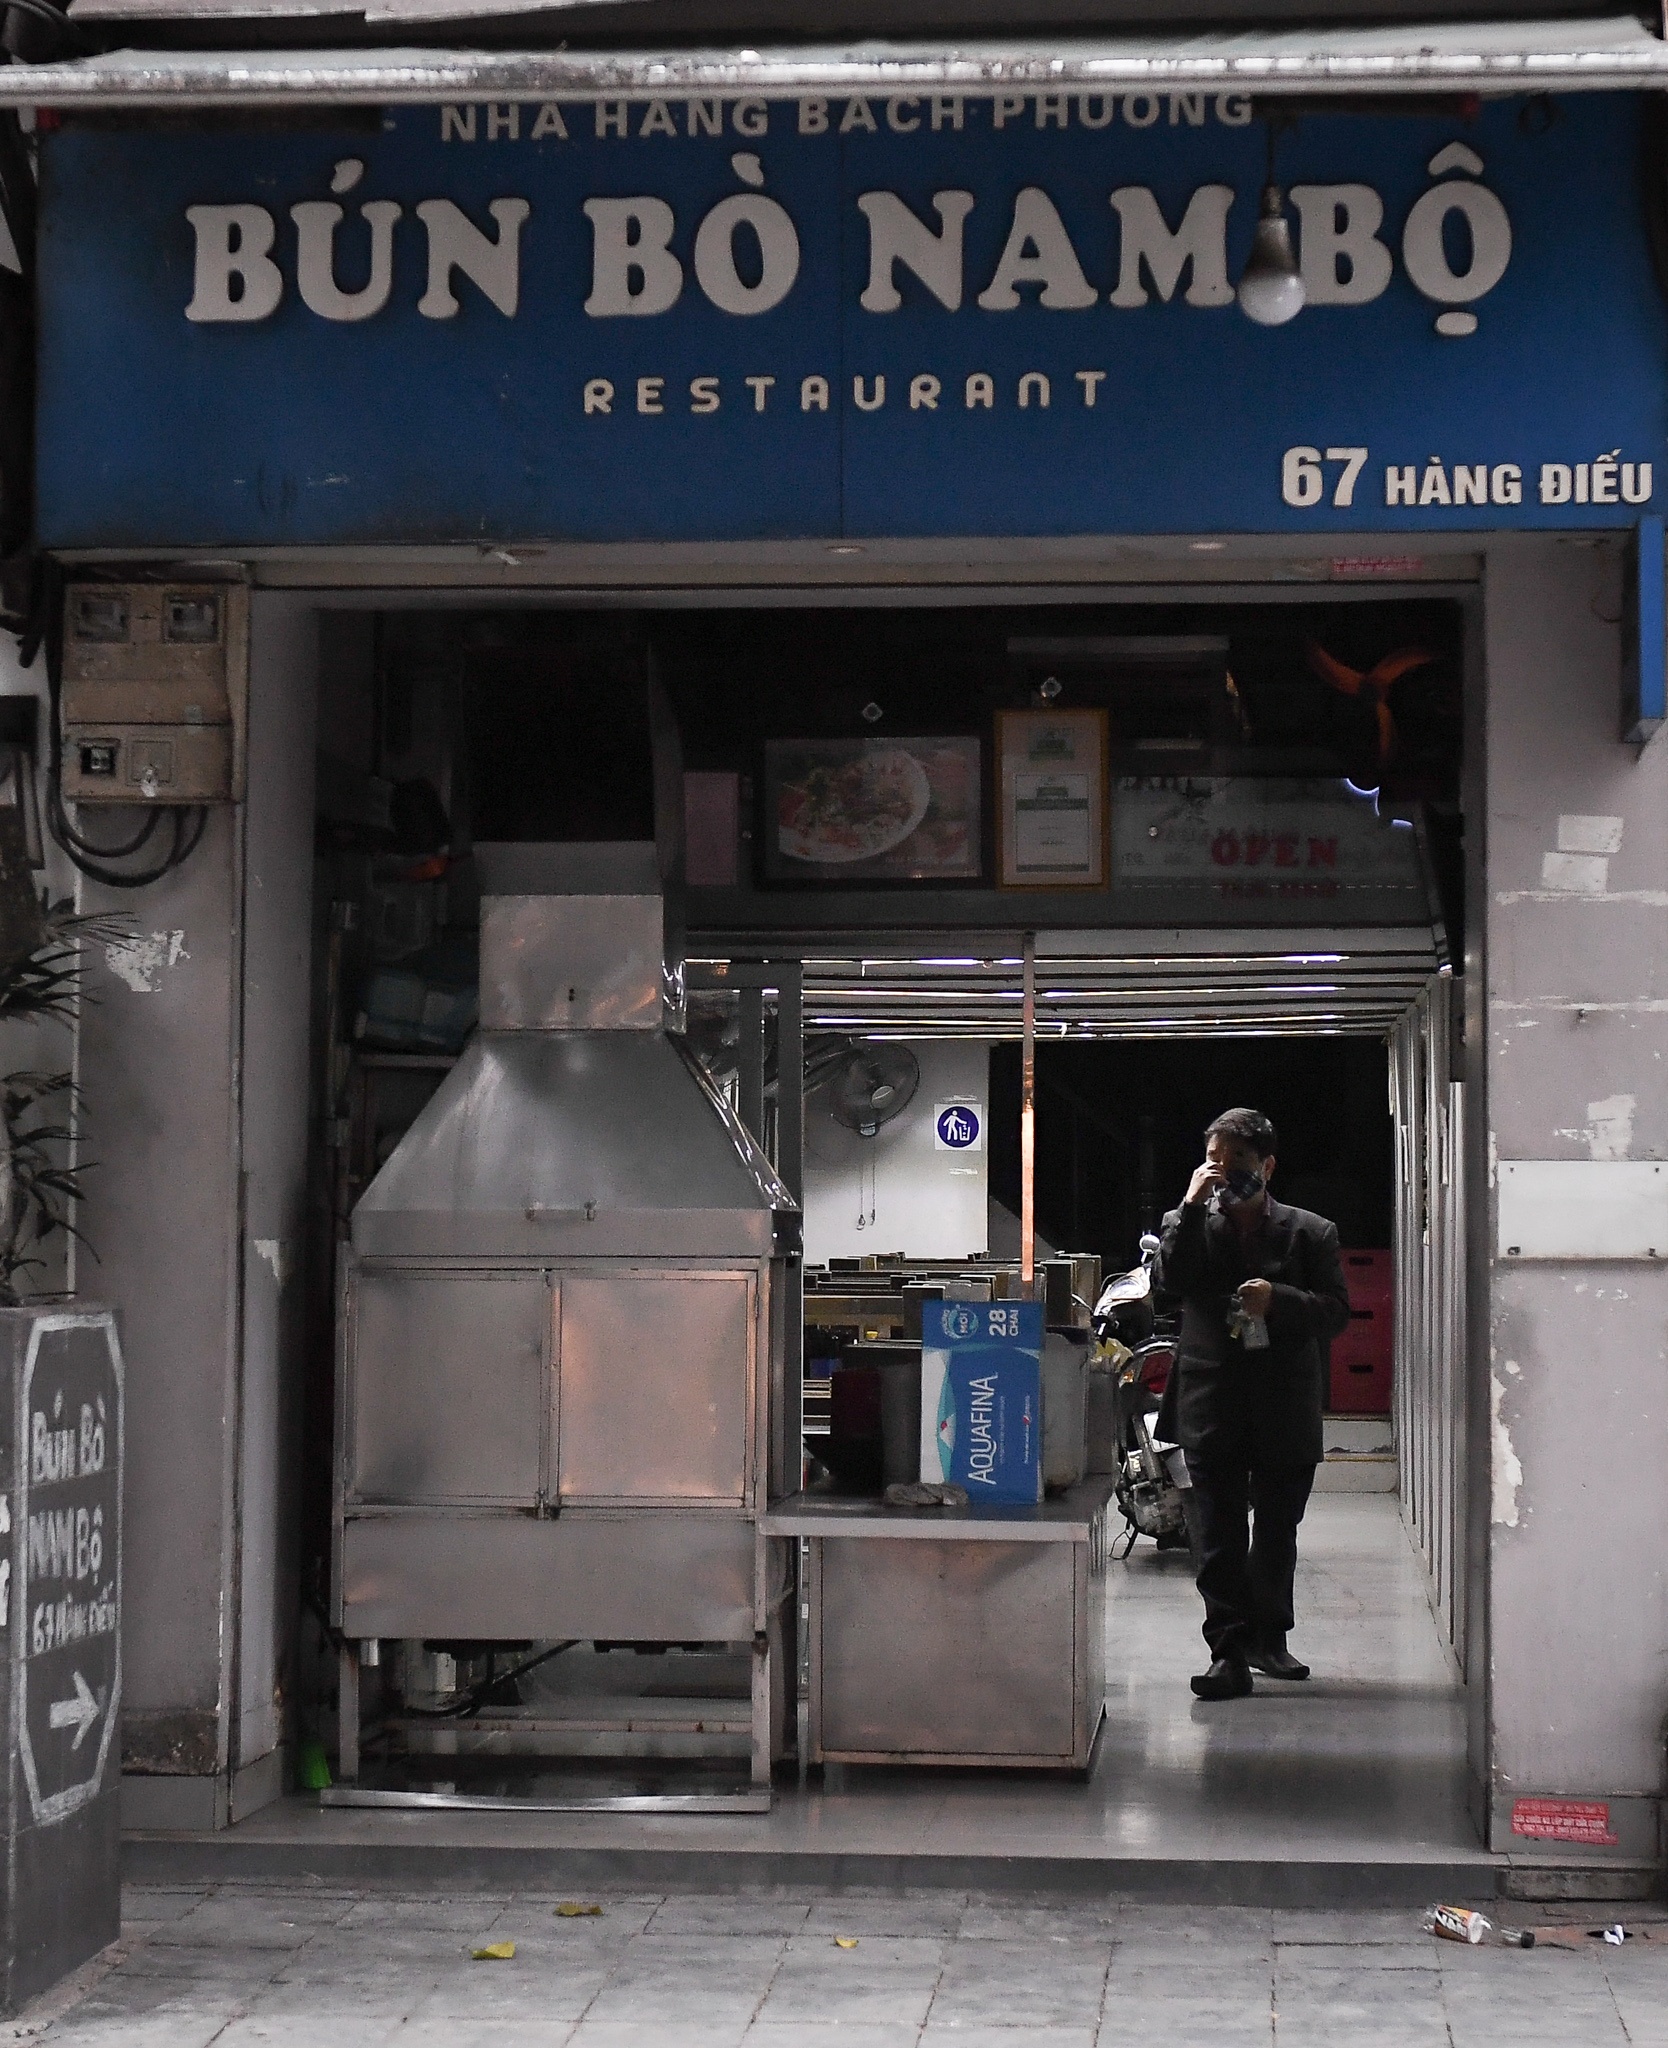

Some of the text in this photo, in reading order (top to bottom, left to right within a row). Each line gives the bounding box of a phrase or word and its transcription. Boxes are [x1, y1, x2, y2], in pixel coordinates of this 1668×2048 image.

[184, 140, 1512, 337] BÚN BÒ NAM BỘ
[583, 370, 1107, 416] RESTAURANT
[1282, 446, 1653, 507] 67 HÀNG ĐIẾU
[1211, 832, 1338, 868] OPEN
[989, 1309, 1007, 1337] 28
[1008, 1309, 1019, 1337] CHAI
[968, 1371, 998, 1485] AQUAFINA
